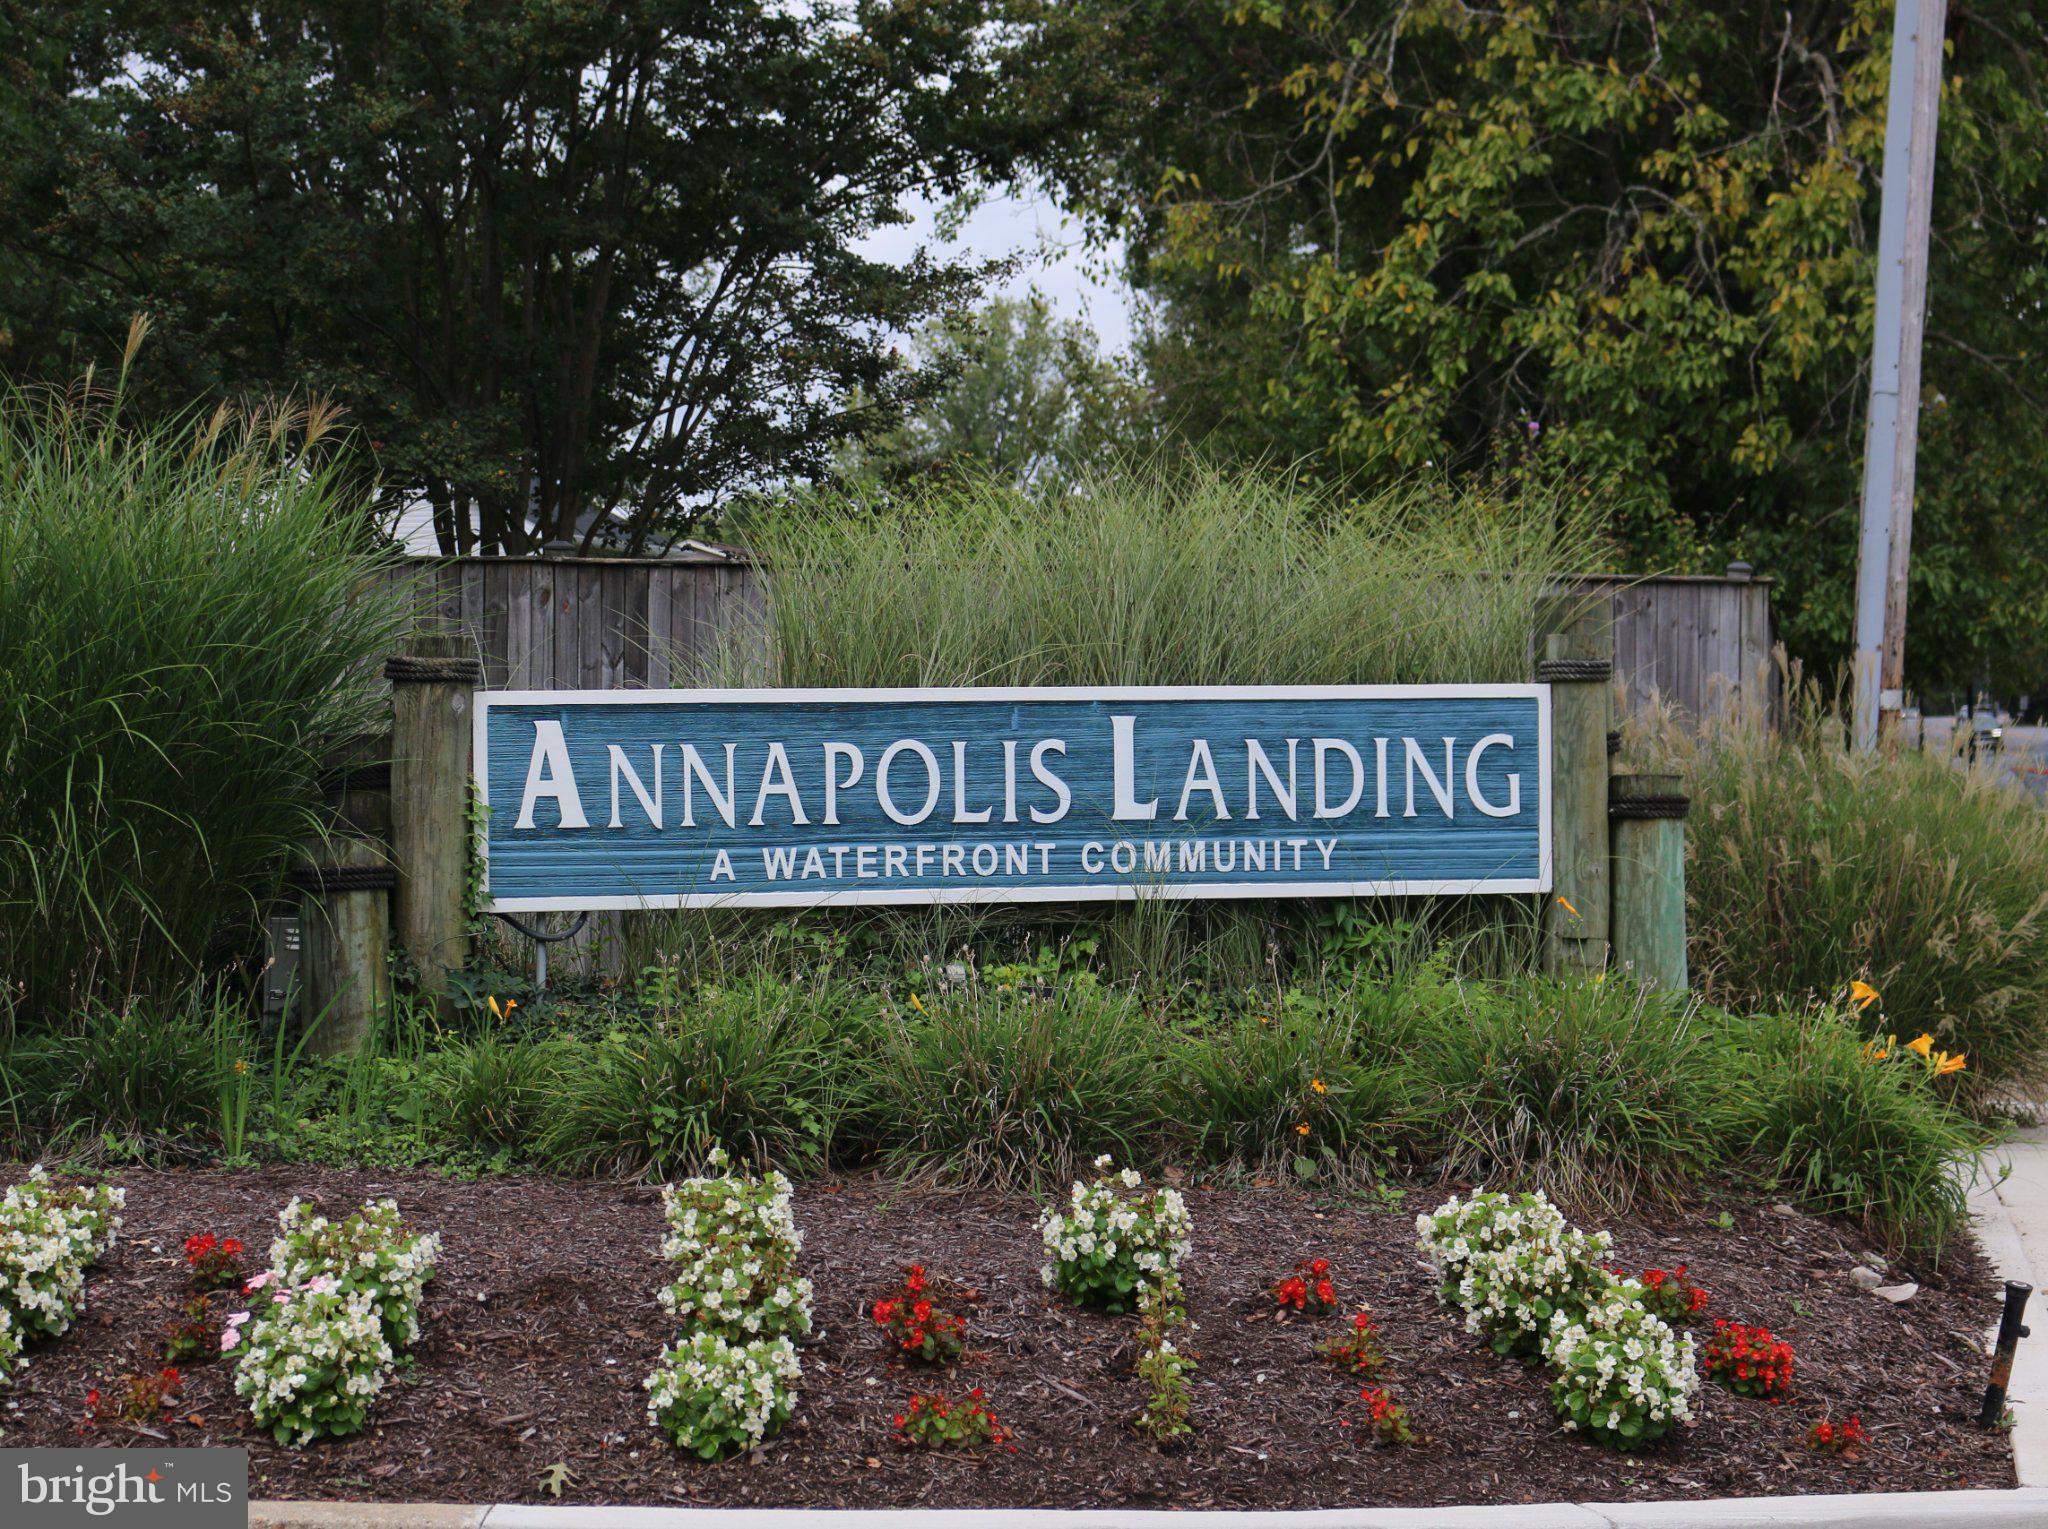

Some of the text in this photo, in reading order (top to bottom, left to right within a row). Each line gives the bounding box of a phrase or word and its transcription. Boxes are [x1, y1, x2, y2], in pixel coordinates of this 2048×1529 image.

[514, 716, 1520, 829] ANNAPOLIS LANDING
[710, 838, 1338, 882] A WATERFRONT COMMUNITY
